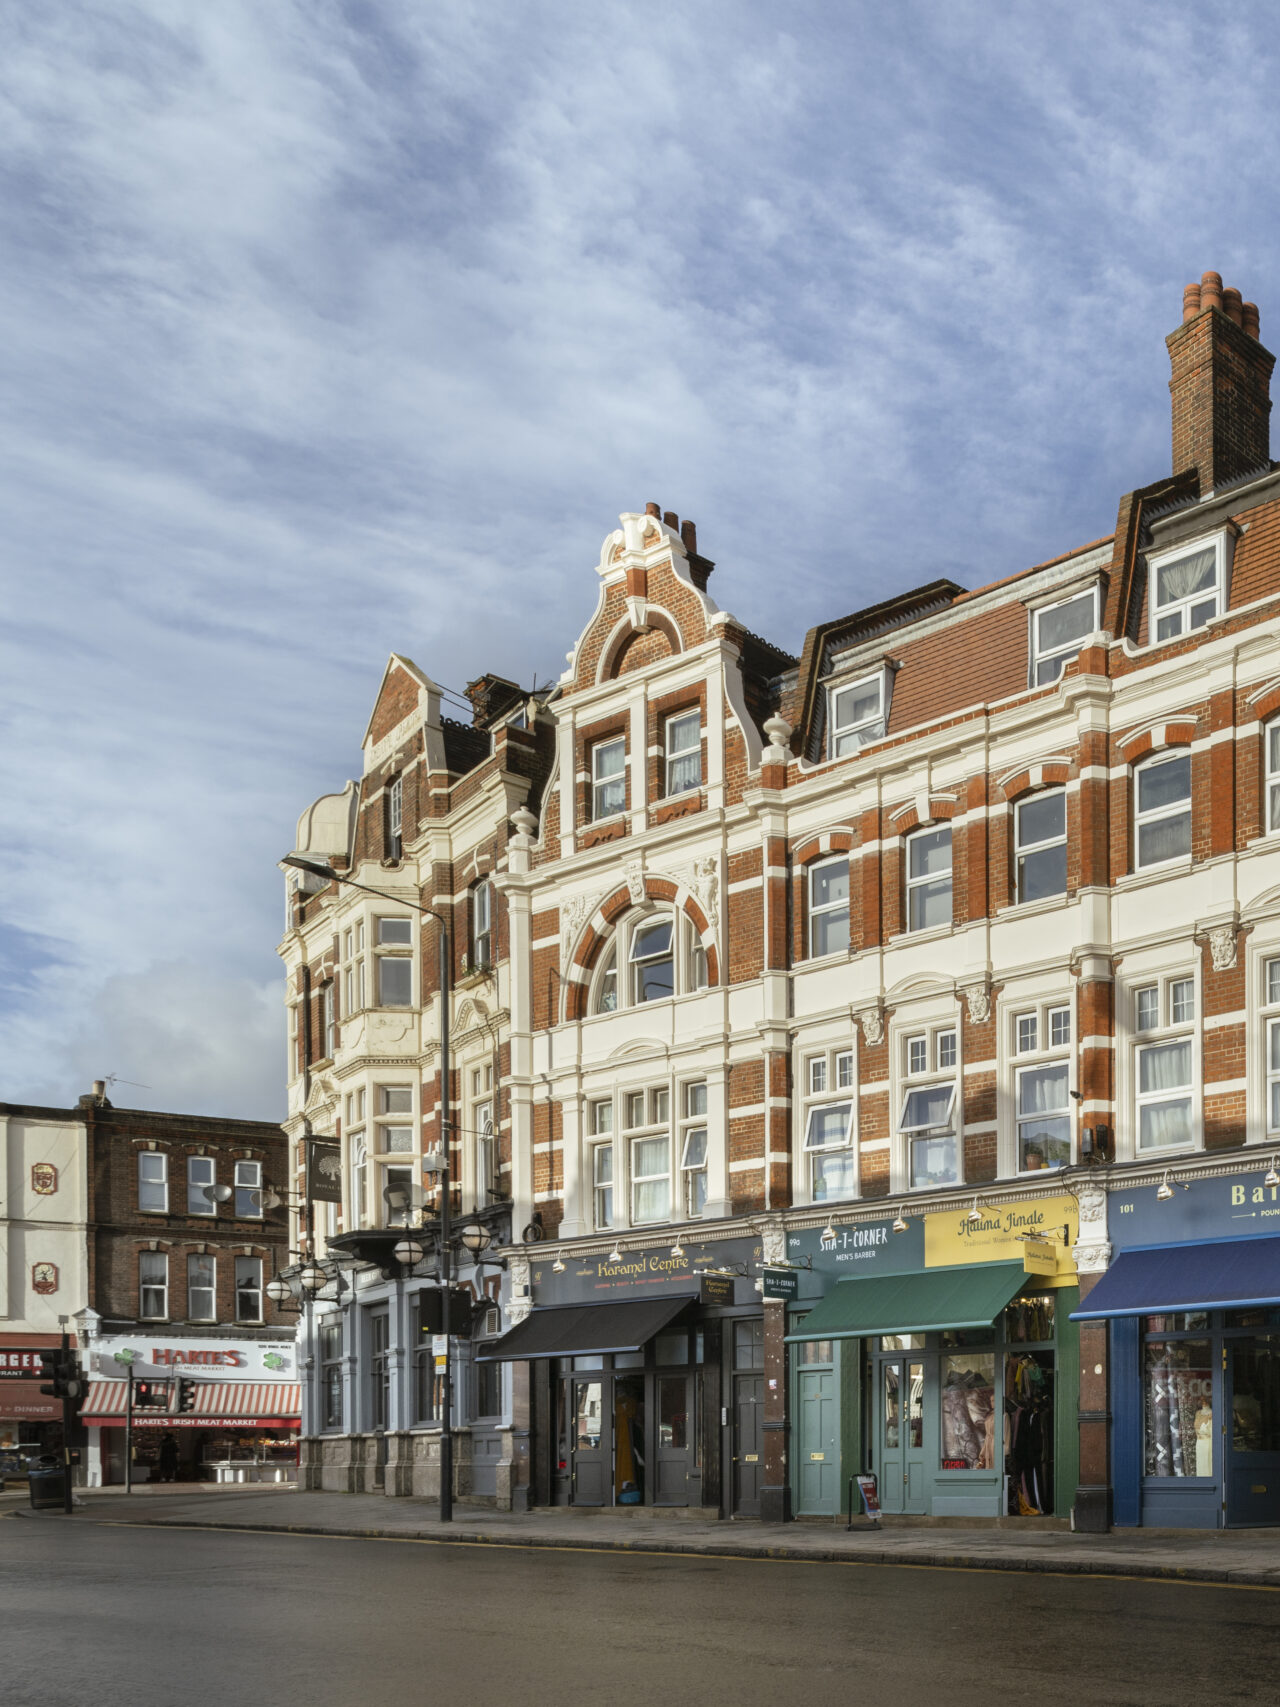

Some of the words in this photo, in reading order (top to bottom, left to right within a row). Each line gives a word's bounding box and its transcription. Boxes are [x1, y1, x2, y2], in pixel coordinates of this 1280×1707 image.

[1063, 1205, 1078, 1214] 99b
[1119, 1204, 1134, 1214] 101
[1003, 1209, 1044, 1233] Jimale
[789, 1238, 800, 1247] 99a
[836, 1253, 854, 1261] MEN'S
[855, 1250, 876, 1260] BARBER
[598, 1258, 647, 1278] Karamel
[649, 1256, 689, 1275] Centre
[152, 1348, 241, 1367] HARTE'S
[134, 1418, 169, 1426] HARTE'S
